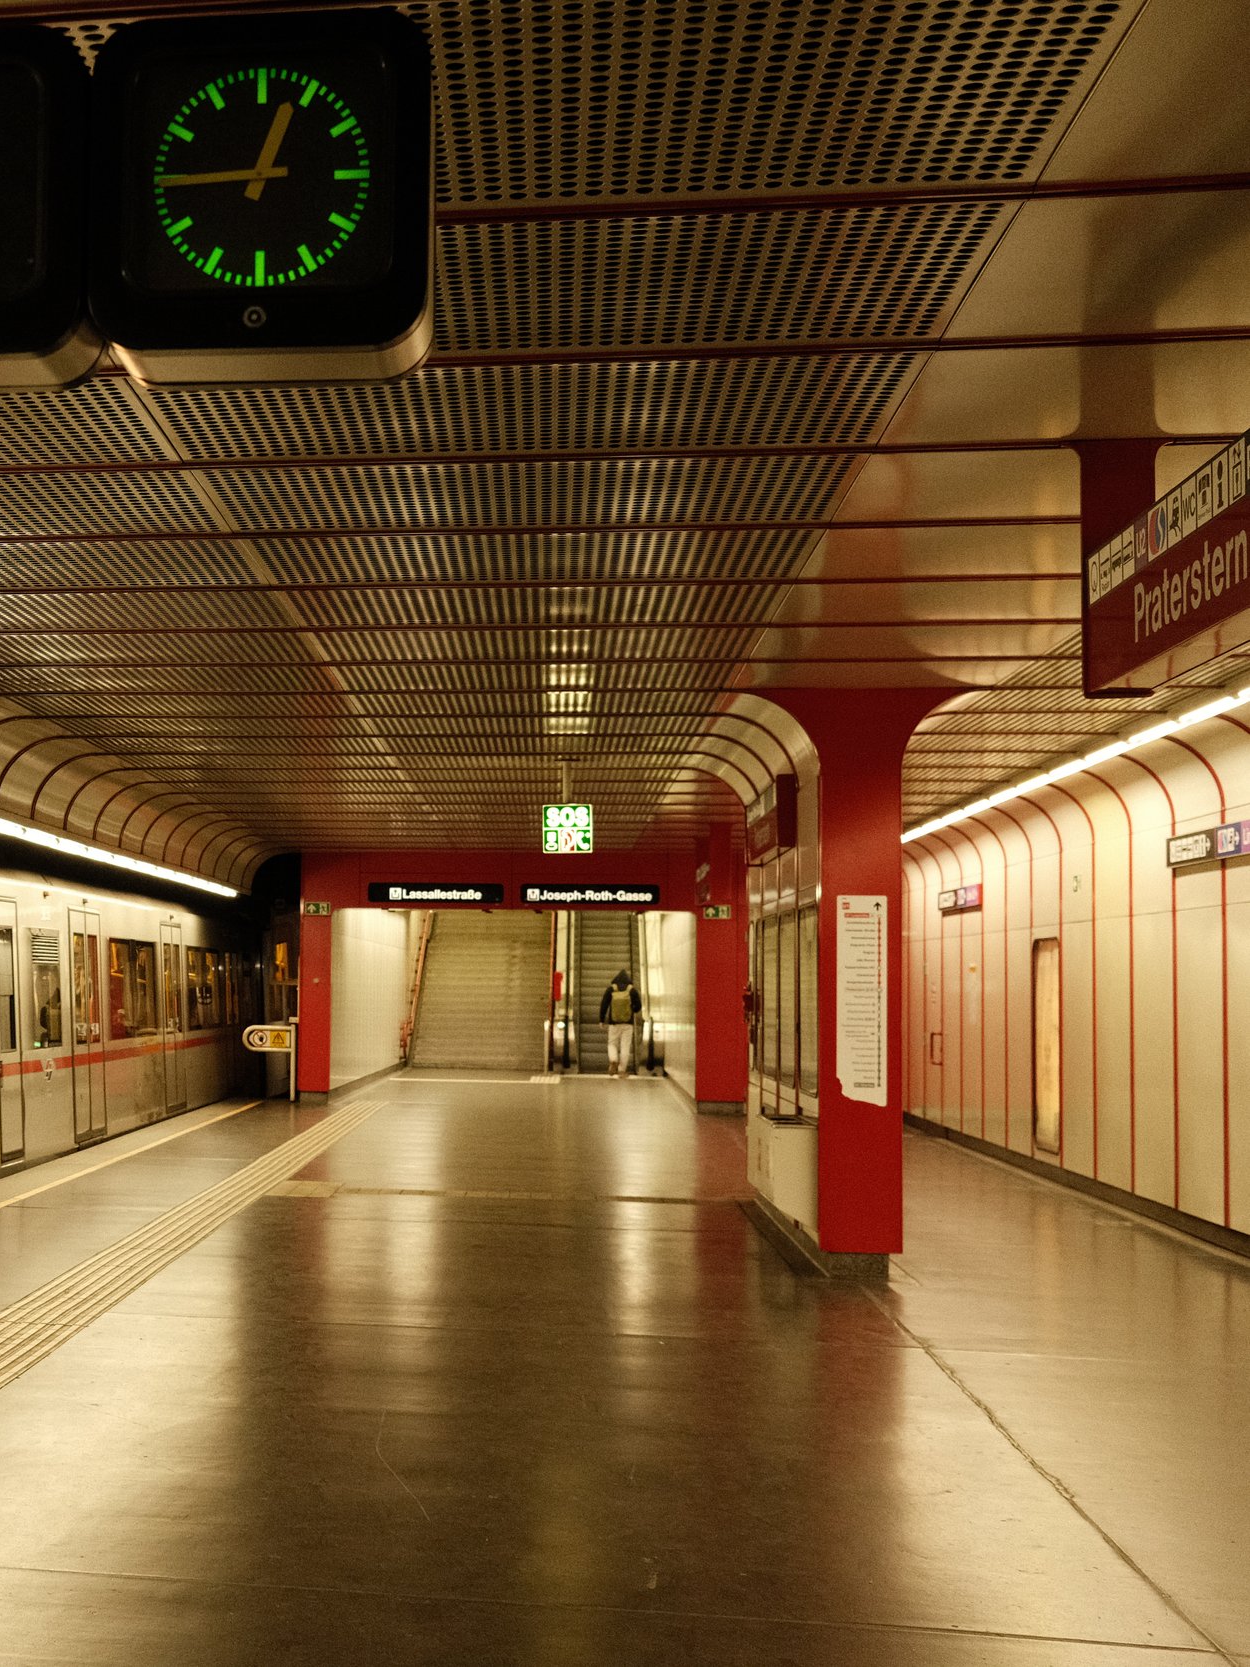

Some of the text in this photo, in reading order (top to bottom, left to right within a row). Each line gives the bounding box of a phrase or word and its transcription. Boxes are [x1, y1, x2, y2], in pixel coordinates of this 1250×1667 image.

[1183, 491, 1196, 522] WC
[1136, 527, 1146, 559] U2
[1133, 528, 1248, 644] Praterstern
[545, 806, 590, 827] SOS
[402, 889, 483, 901] Lassallestraße
[539, 889, 653, 903] Joseph-Roth-Gasse
